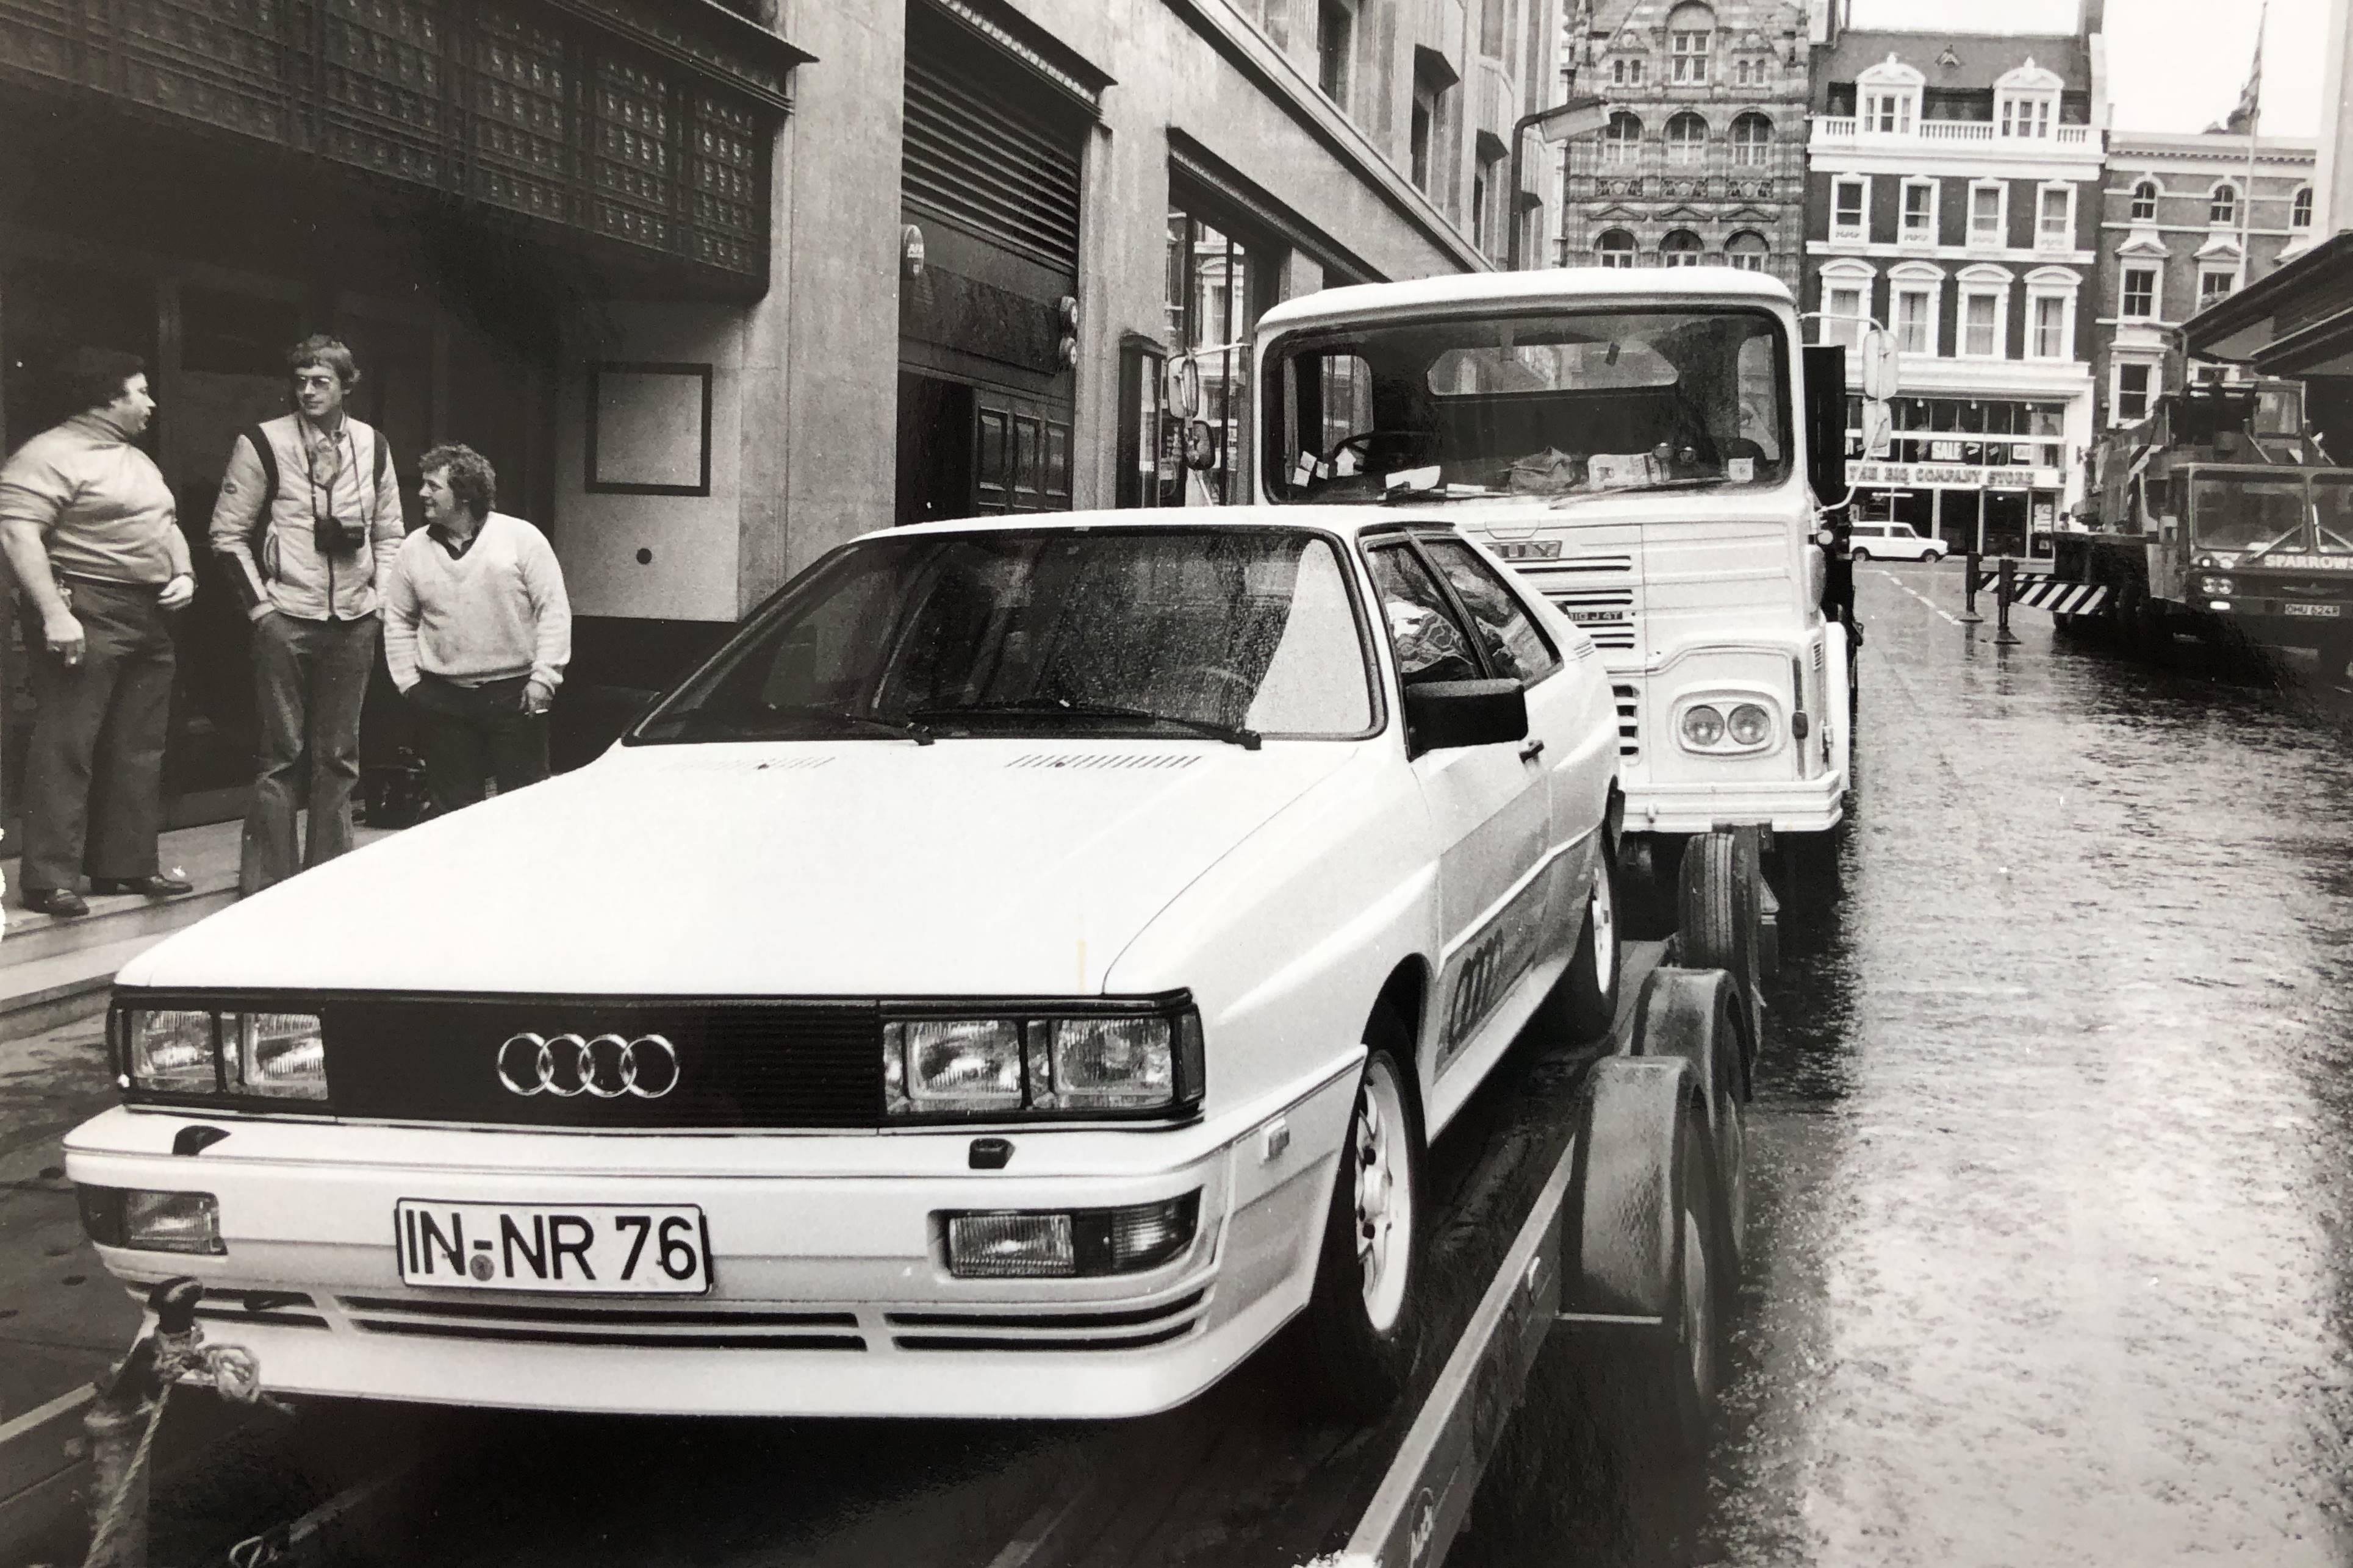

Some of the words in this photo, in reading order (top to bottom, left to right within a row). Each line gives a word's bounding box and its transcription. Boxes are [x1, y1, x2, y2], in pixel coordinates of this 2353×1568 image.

[1932, 442, 1963, 460] SALE
[1916, 468, 1982, 484] COMPANY
[1988, 470, 2035, 485] STORE
[405, 1209, 597, 1280] IN-NR
[614, 1215, 697, 1280] 76
